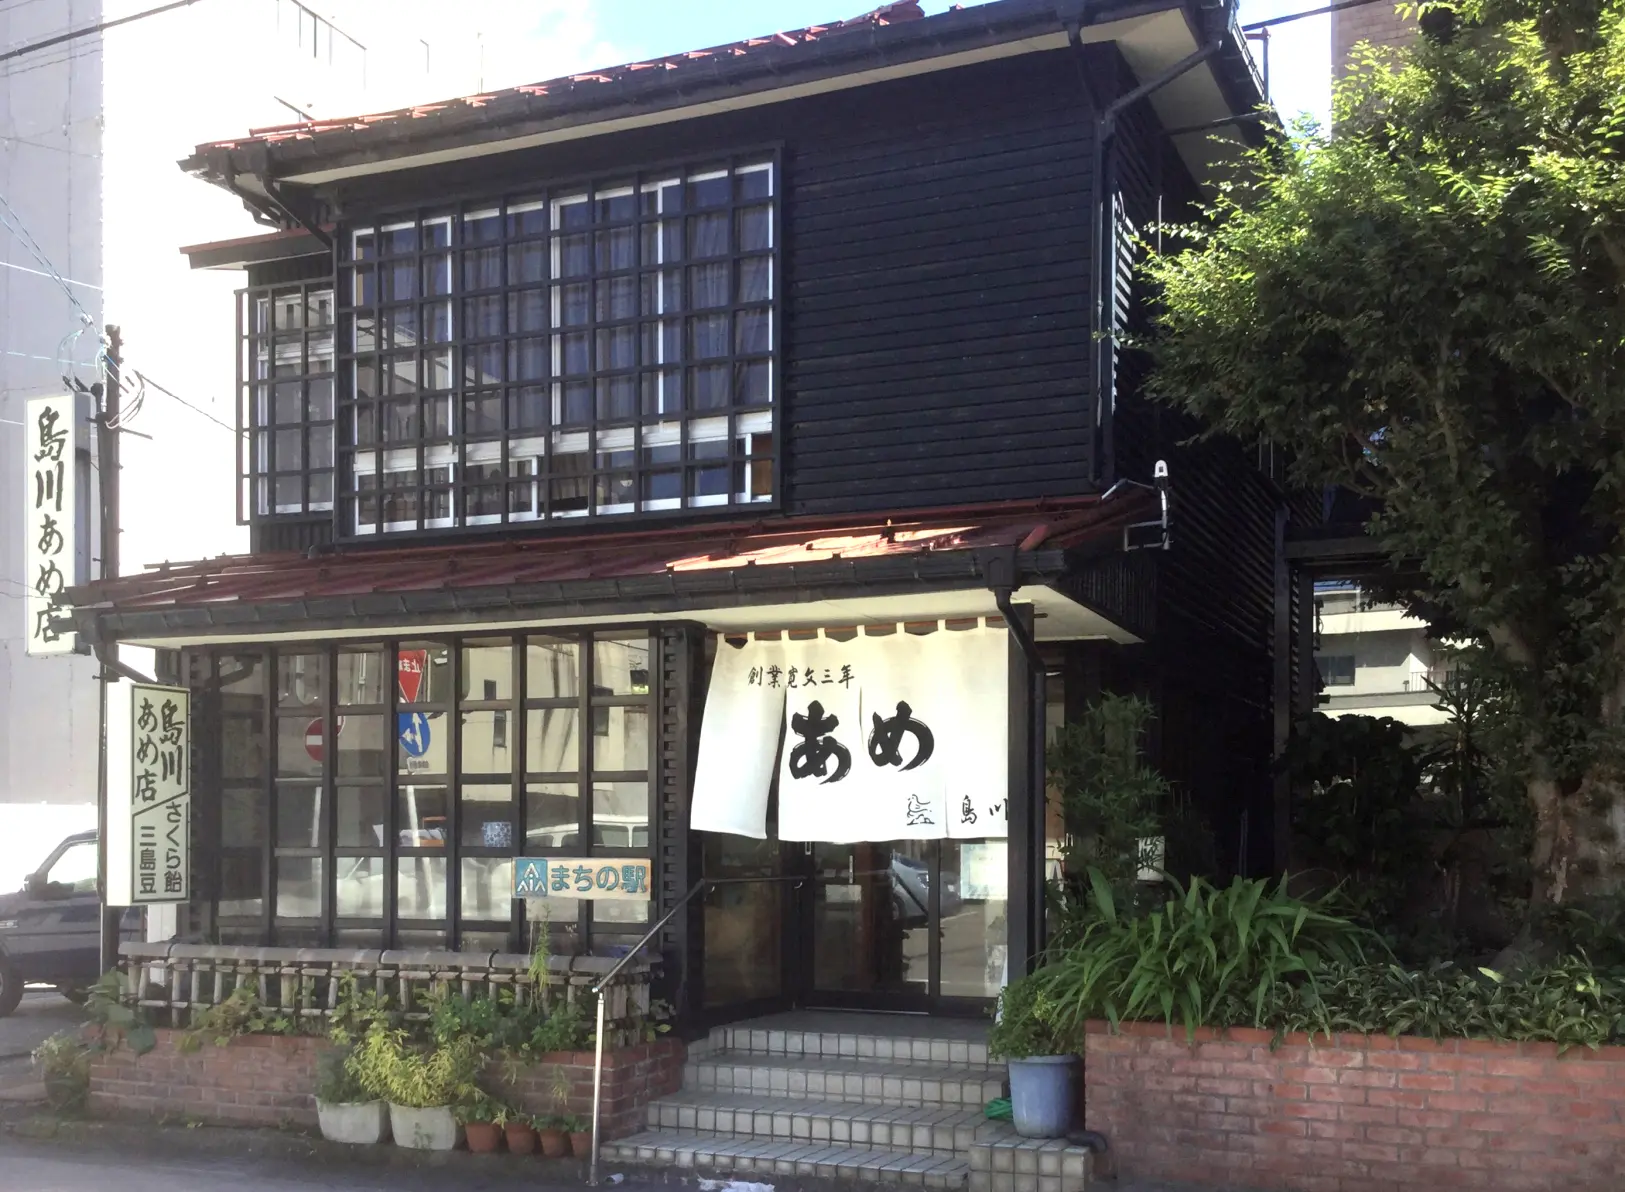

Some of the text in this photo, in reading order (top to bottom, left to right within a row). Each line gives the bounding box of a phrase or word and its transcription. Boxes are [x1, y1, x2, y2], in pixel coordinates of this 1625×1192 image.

[135, 697, 158, 802] あめ店
[159, 699, 185, 785] 島川
[789, 699, 935, 785] あめ
[139, 825, 157, 894] 三島豆
[163, 801, 182, 893] さくら飴
[551, 864, 647, 893] まちの駅
